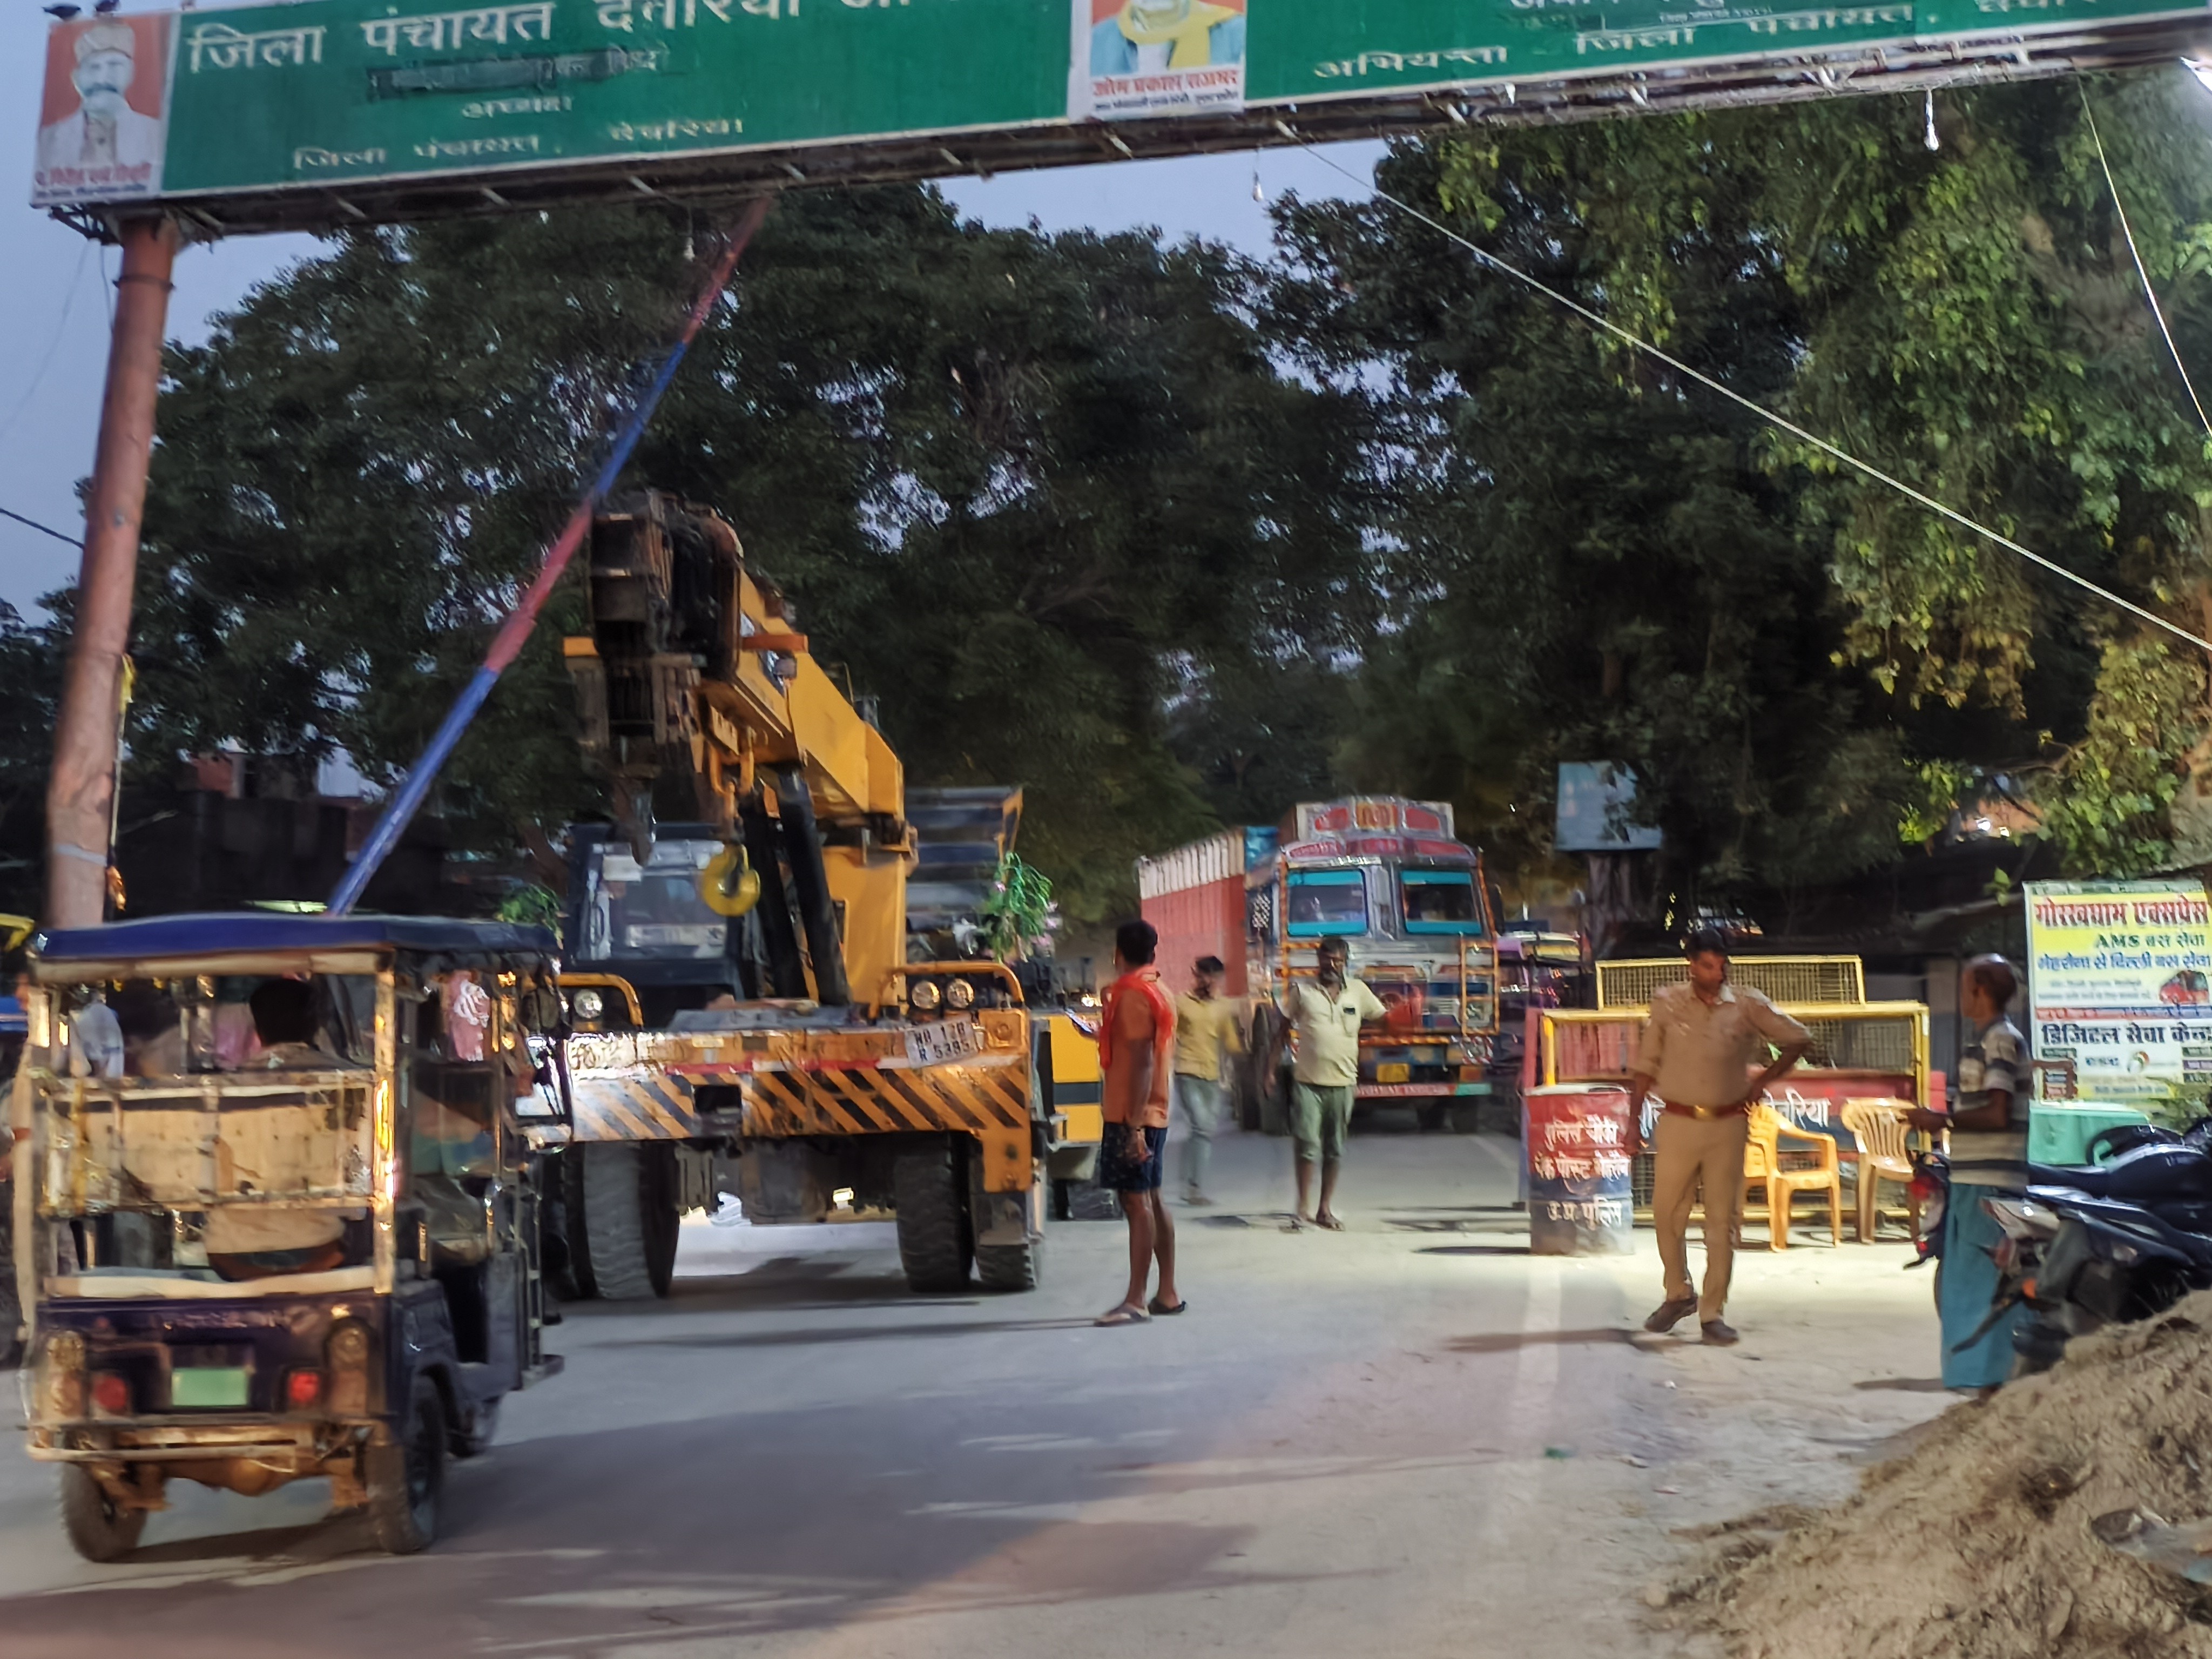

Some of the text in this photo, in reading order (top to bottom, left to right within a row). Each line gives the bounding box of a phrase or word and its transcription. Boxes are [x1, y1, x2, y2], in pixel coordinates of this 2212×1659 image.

[187, 23, 326, 73] जिला
[360, 2, 556, 56] पंचायत
[2096, 934, 2140, 949] AMS
[2041, 1023, 2121, 1044] डिजिटल
[2126, 1022, 2166, 1043] सेवा
[1581, 1195, 1622, 1231] पुलिस
